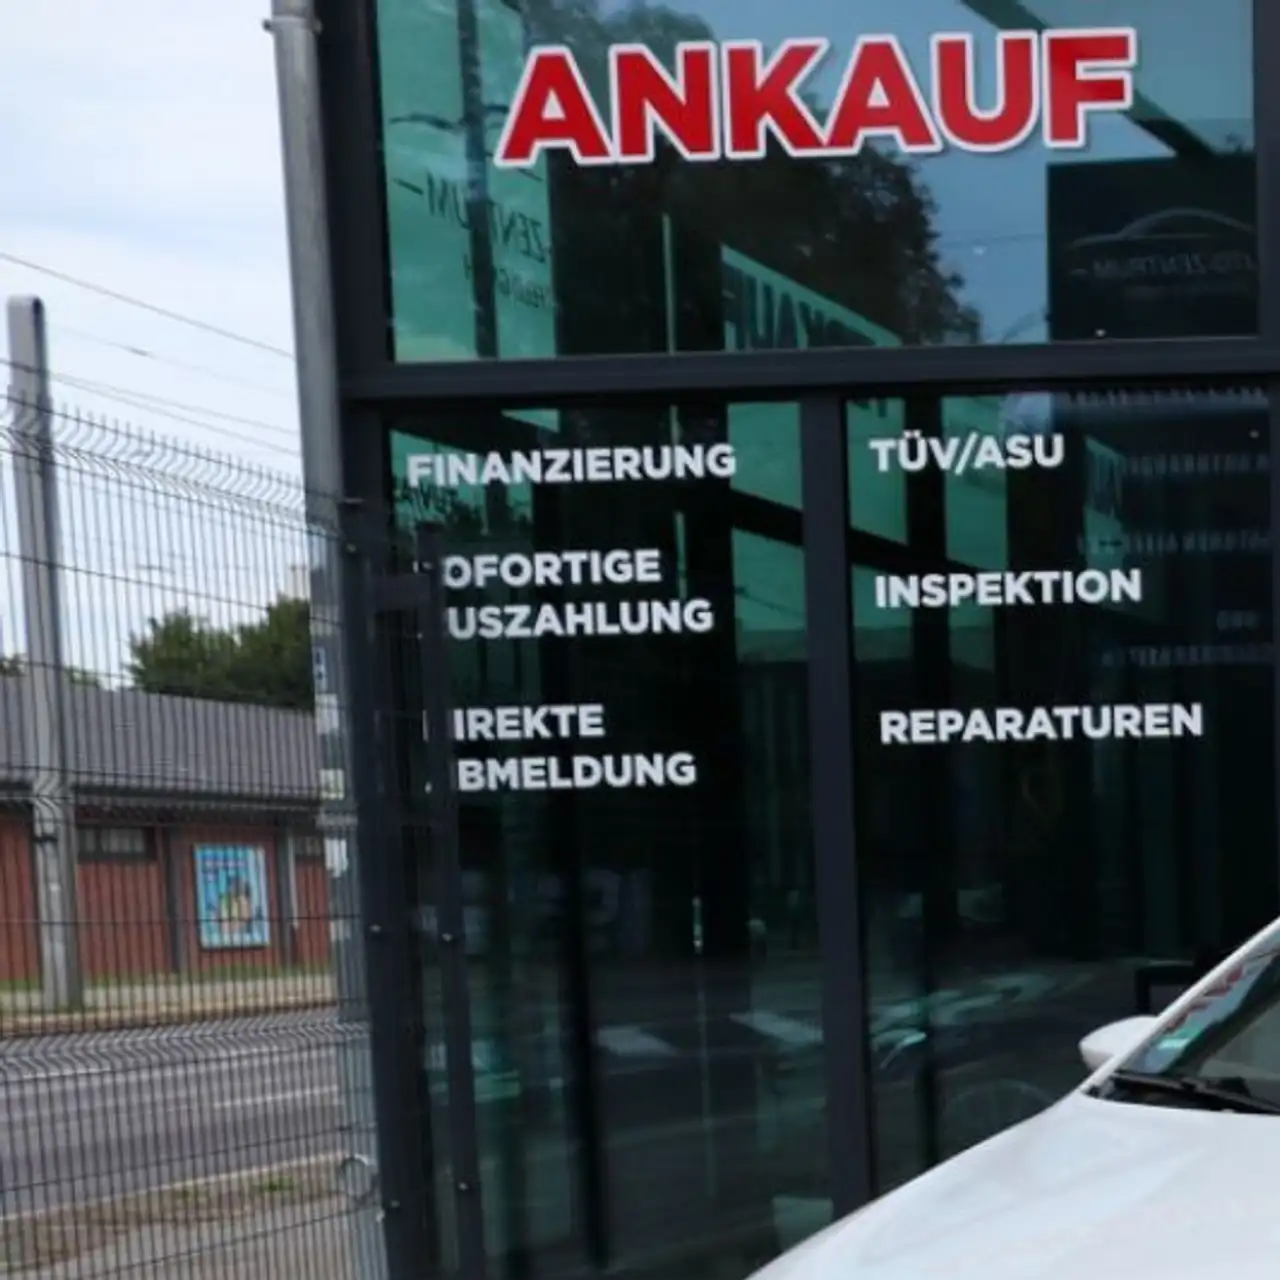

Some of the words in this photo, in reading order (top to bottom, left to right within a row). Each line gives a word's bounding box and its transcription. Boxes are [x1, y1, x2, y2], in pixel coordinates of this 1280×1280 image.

[494, 28, 1136, 167] ANKAUF
[407, 443, 737, 487] FINANZIERUNG
[869, 430, 1064, 476] TÜV/ASU
[438, 548, 663, 589] OFORTIGE
[874, 568, 1142, 609] INSPEKTION
[444, 598, 714, 640] USZAHLUNG
[452, 703, 606, 742] IREKTE
[879, 702, 1204, 745] REPARATUREN
[457, 751, 697, 792] BMELDUNG
